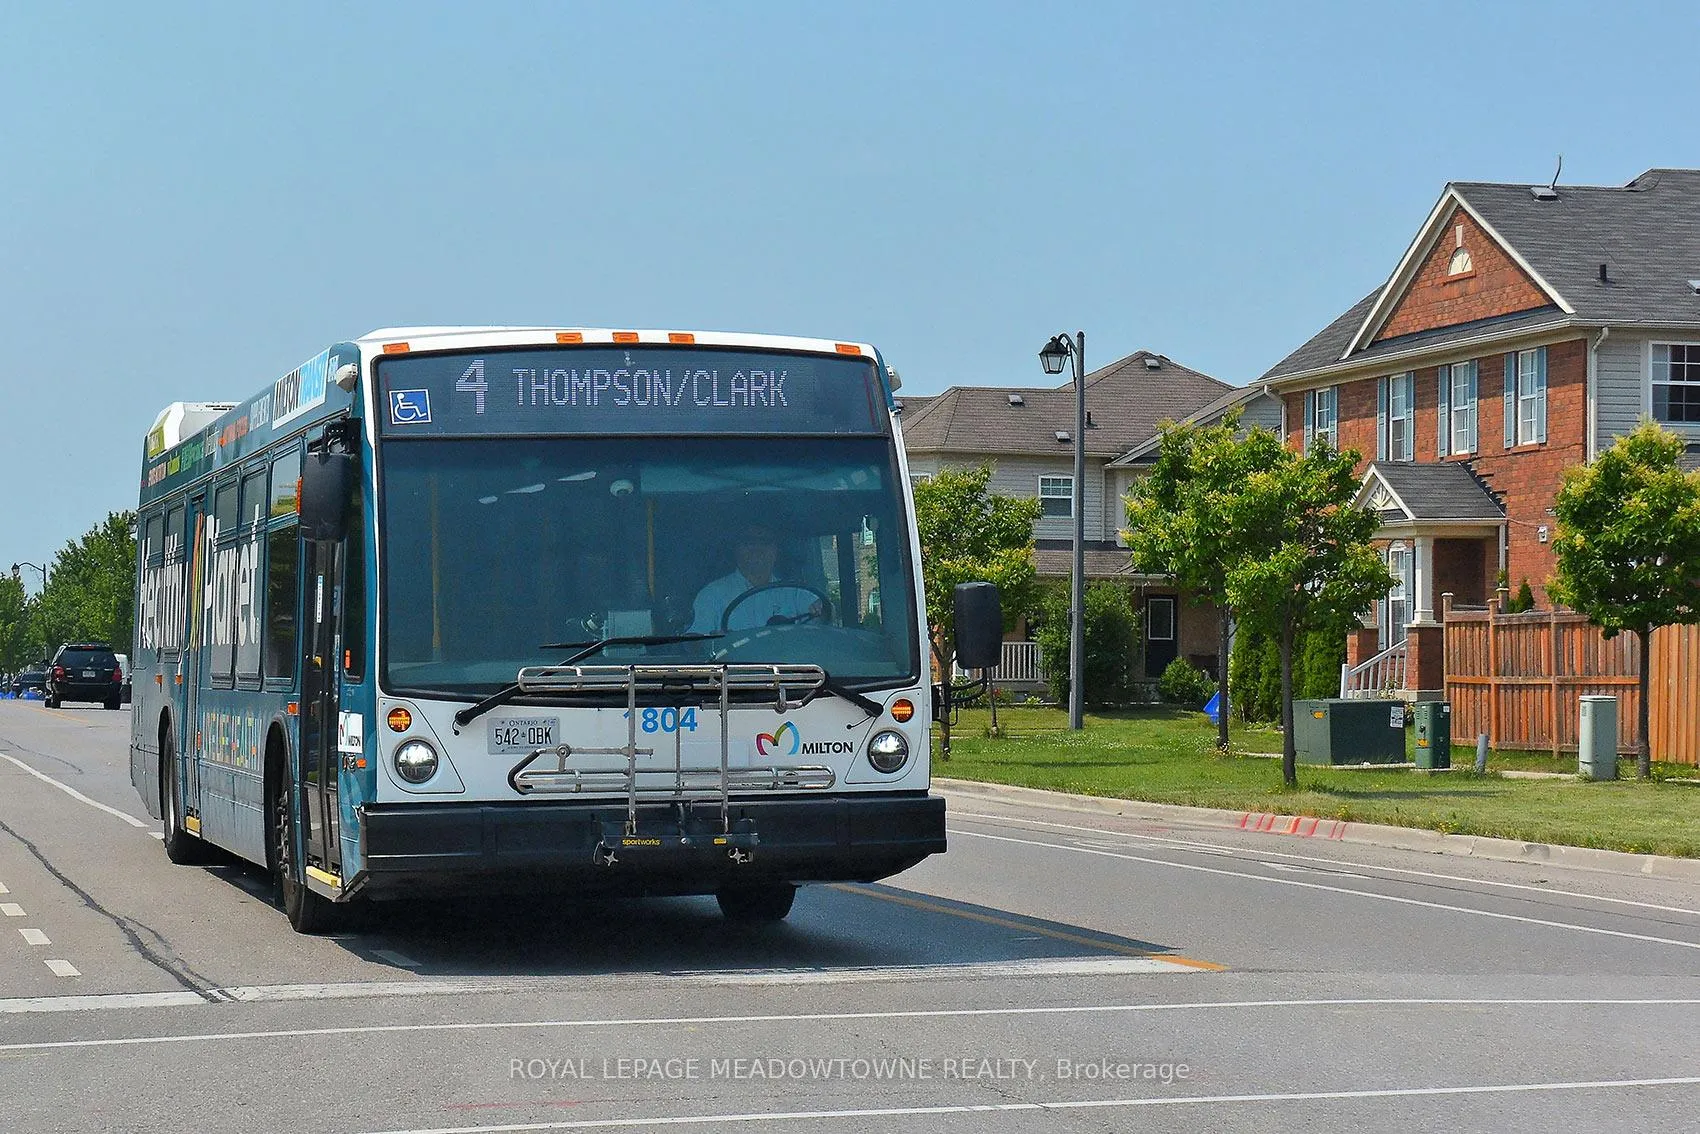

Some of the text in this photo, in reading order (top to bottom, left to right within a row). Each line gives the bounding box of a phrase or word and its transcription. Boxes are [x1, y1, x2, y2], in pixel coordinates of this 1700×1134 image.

[455, 359, 788, 414] 4 THOMPSON/CLARK
[203, 503, 259, 646] Planet
[495, 728, 519, 745] 542
[801, 741, 854, 754] MILTON
[622, 838, 660, 847] sportworks
